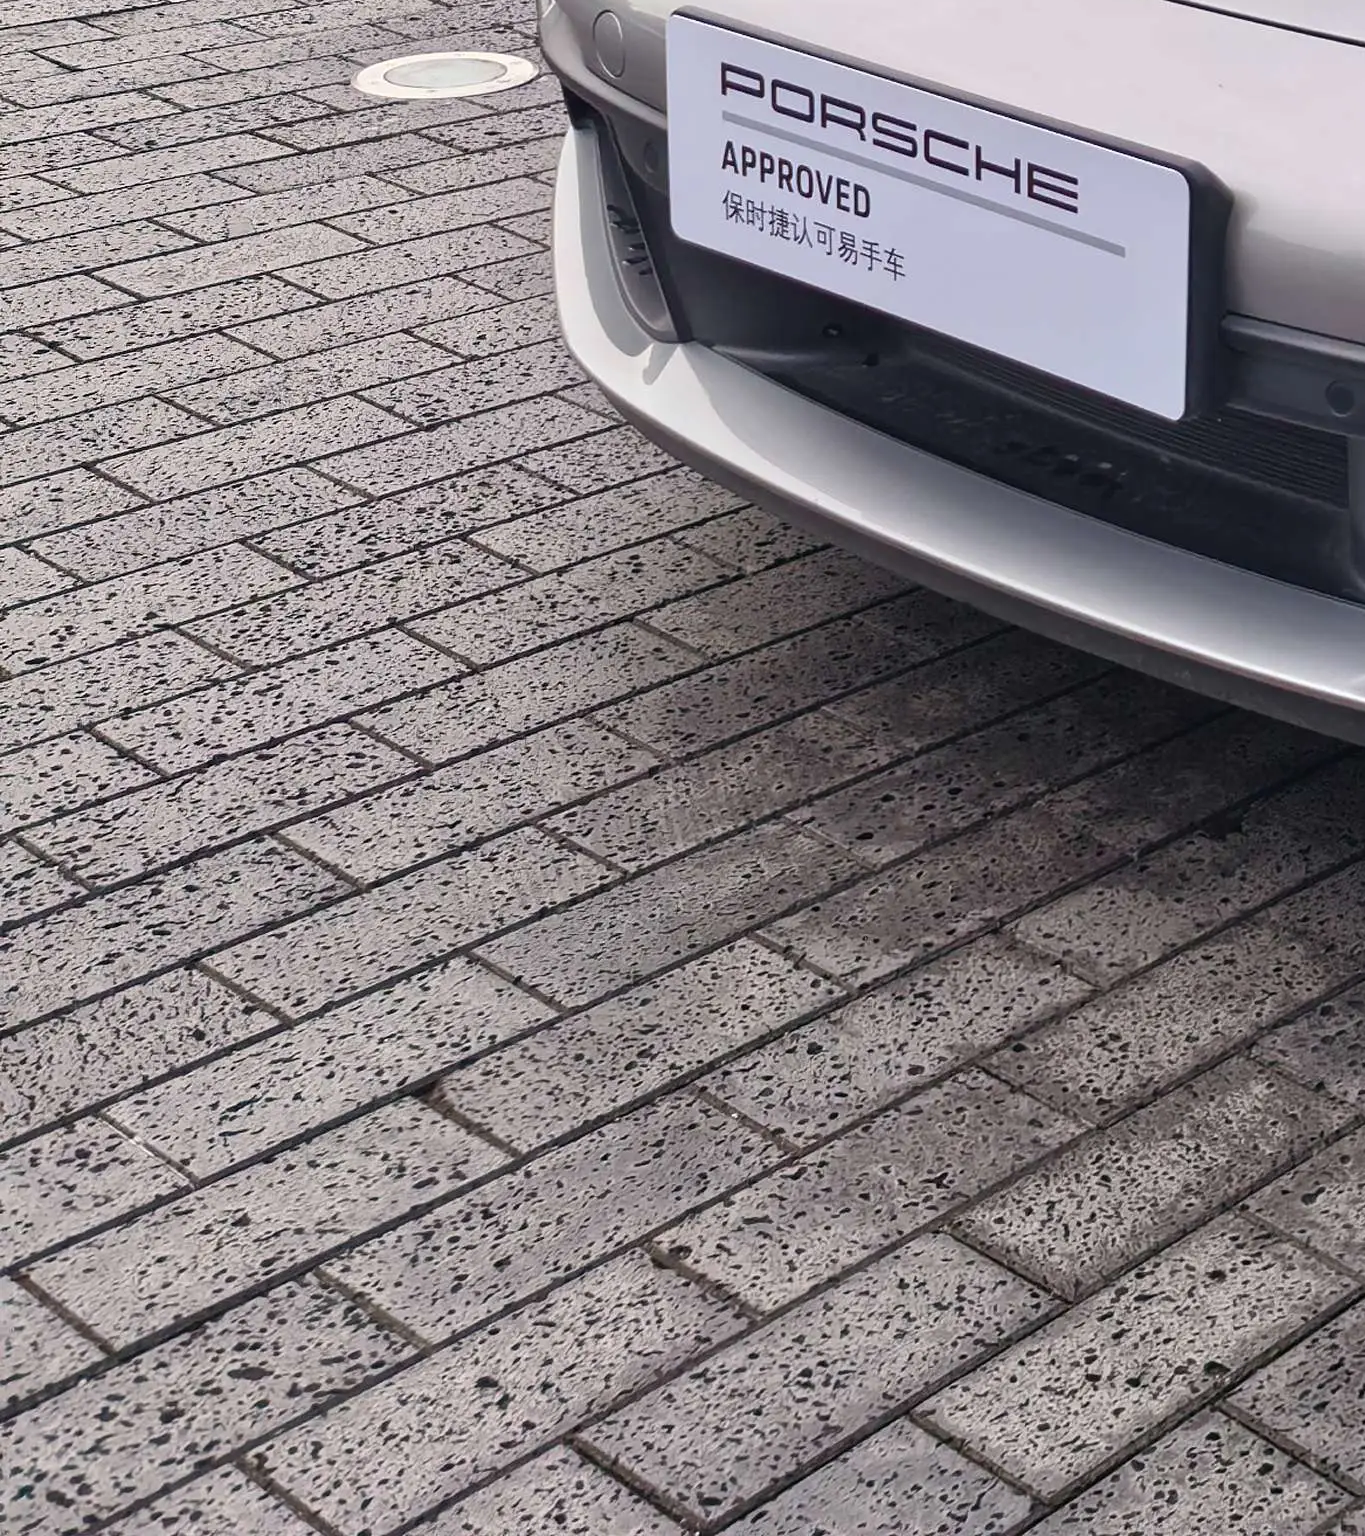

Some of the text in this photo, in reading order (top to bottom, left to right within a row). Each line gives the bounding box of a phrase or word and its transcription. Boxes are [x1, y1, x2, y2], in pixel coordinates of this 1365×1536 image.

[721, 61, 1079, 215] PORSCHE
[721, 140, 871, 219] APPROVED
[722, 189, 906, 282] 保时捷认可易手车
